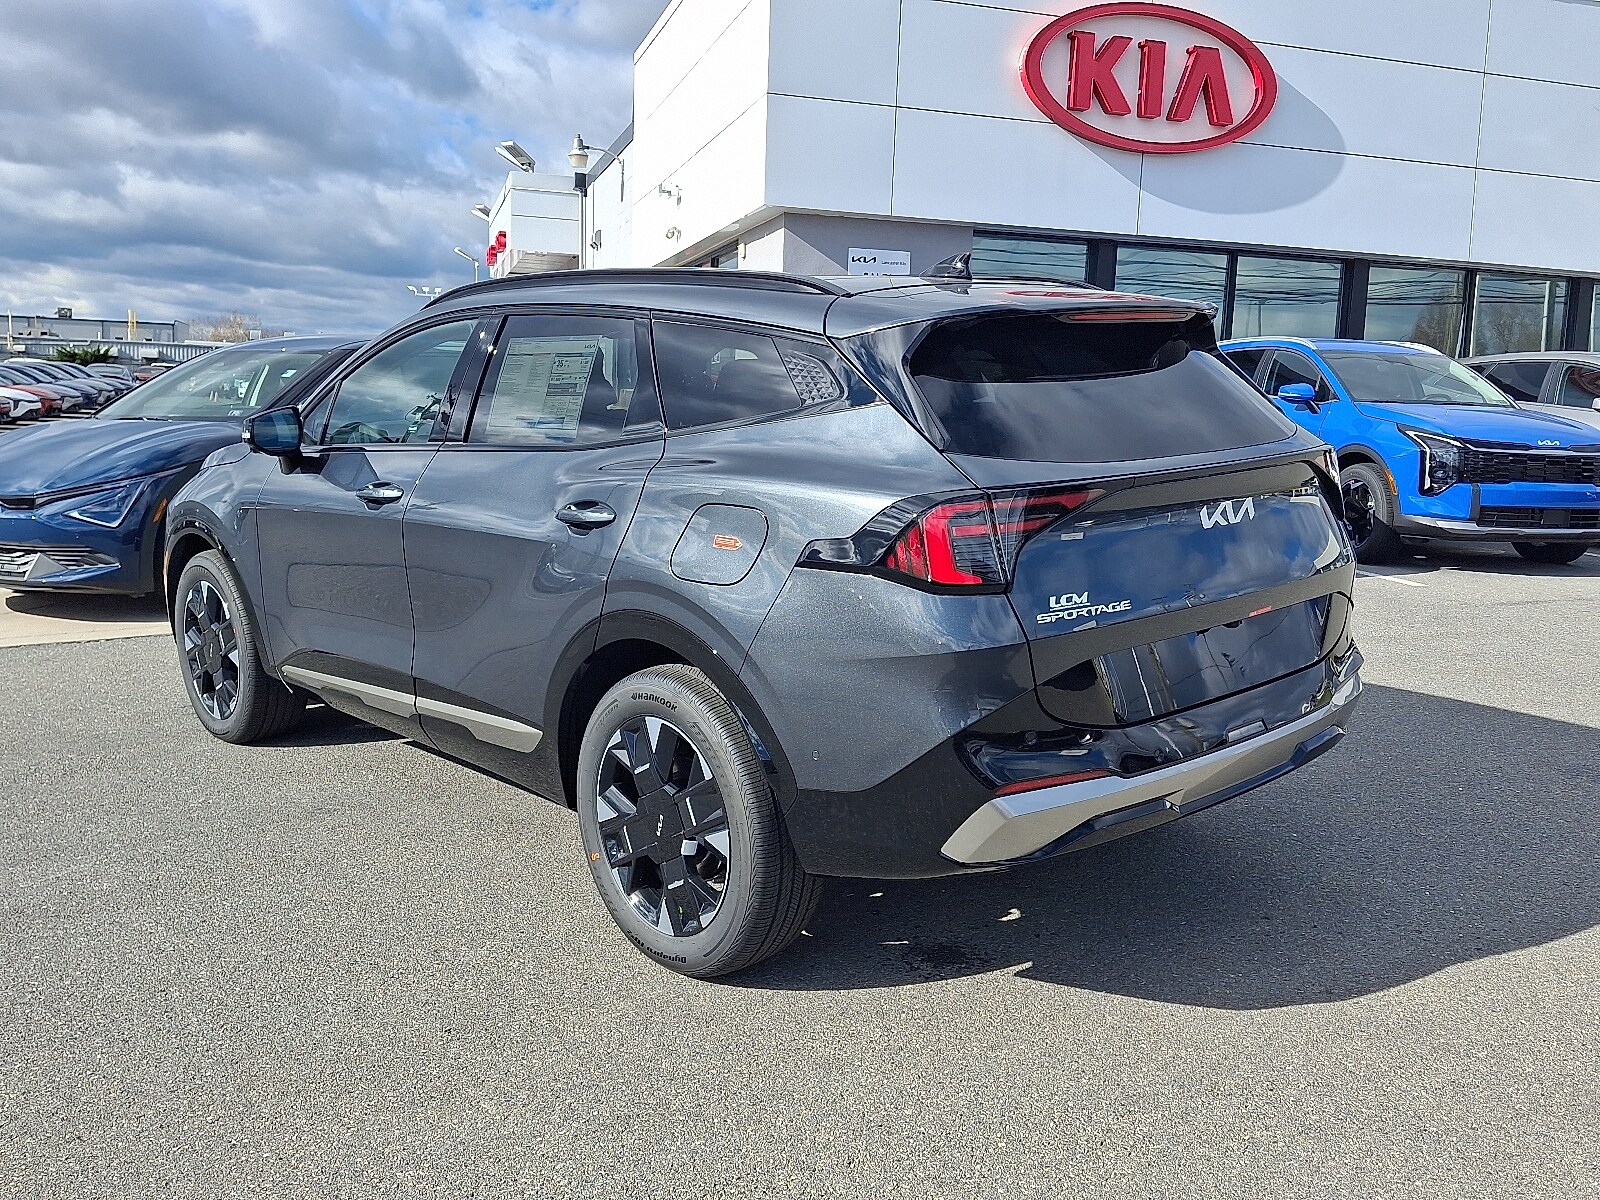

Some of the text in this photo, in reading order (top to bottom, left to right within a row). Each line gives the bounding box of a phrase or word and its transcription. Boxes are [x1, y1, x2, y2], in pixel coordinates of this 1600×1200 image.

[1066, 30, 1234, 127] KIA
[851, 255, 877, 264] KIA
[1200, 497, 1255, 530] KIA
[1049, 591, 1089, 608] LCM
[1036, 600, 1132, 624] SPORTAGE
